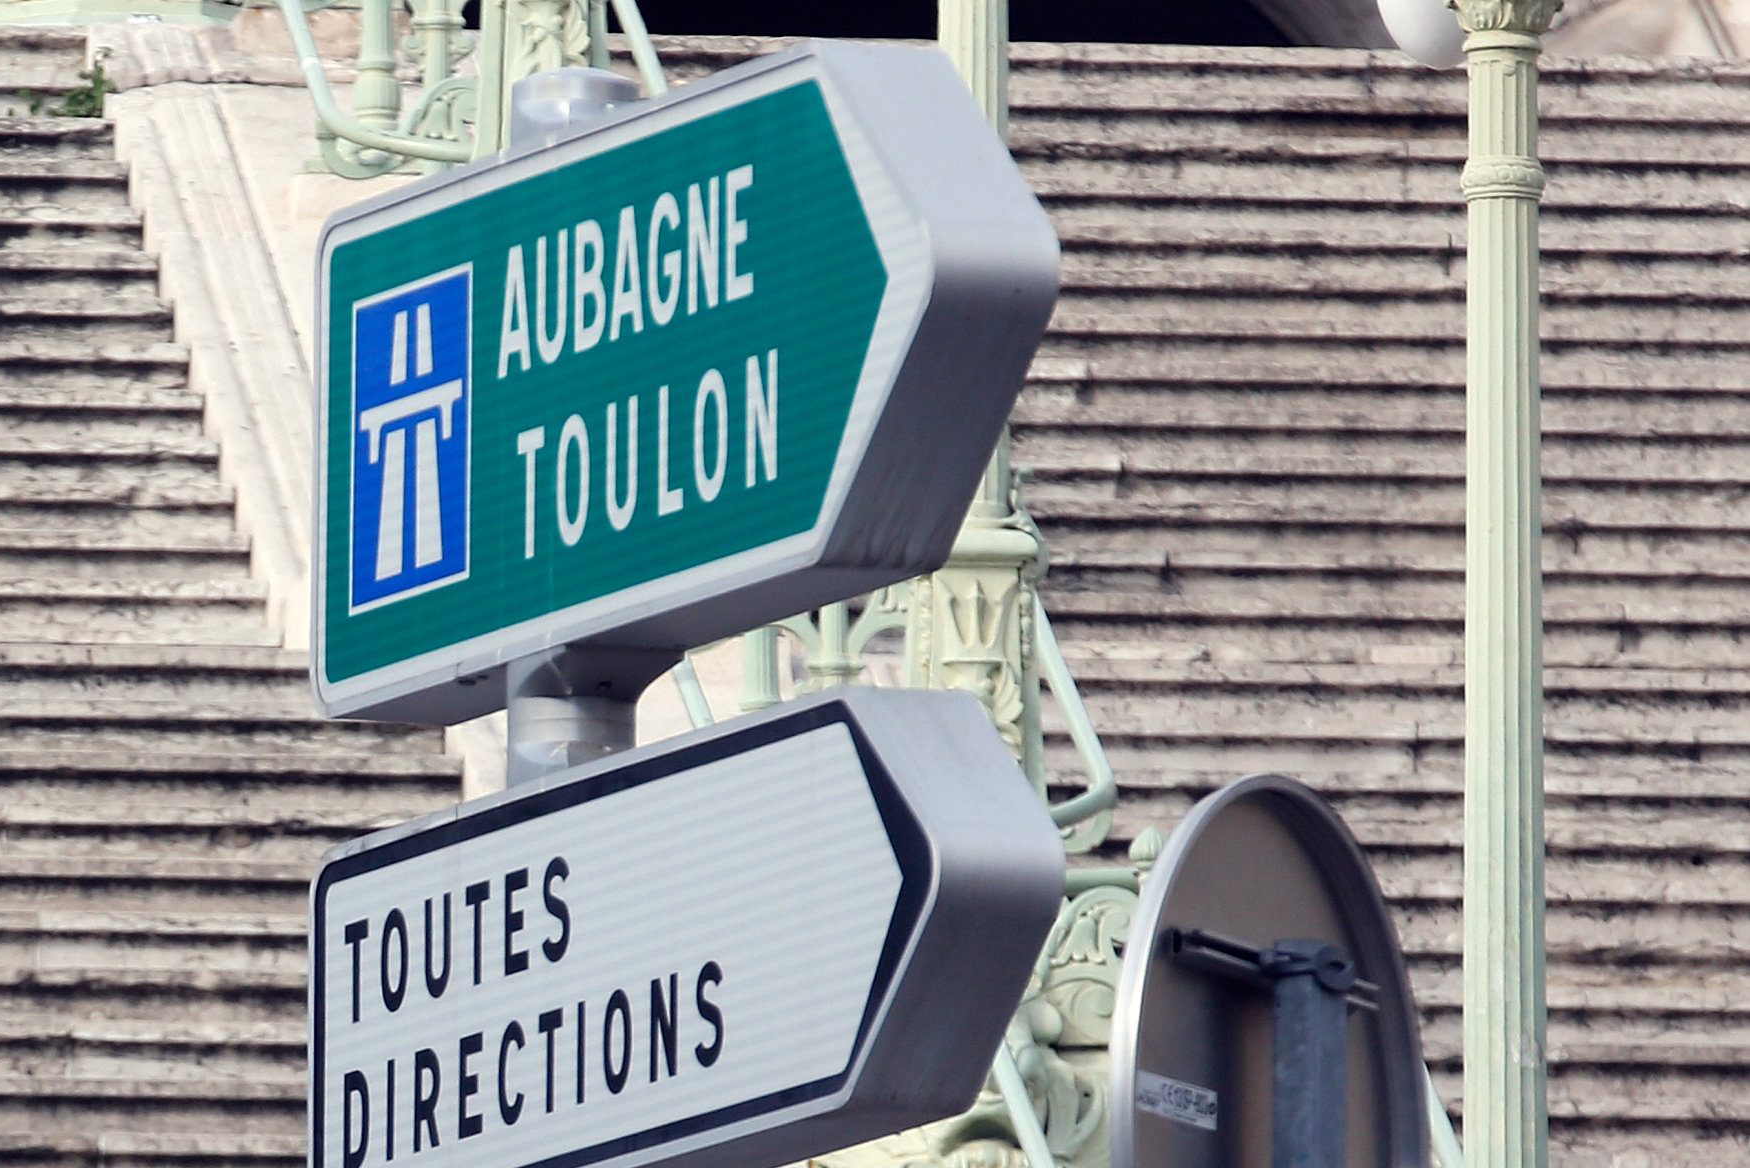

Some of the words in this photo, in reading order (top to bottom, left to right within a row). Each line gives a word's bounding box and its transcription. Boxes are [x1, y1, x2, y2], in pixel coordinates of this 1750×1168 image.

[497, 163, 755, 379] AUBAGNE
[516, 348, 779, 559] TOULON
[344, 856, 572, 1024] TOUTES
